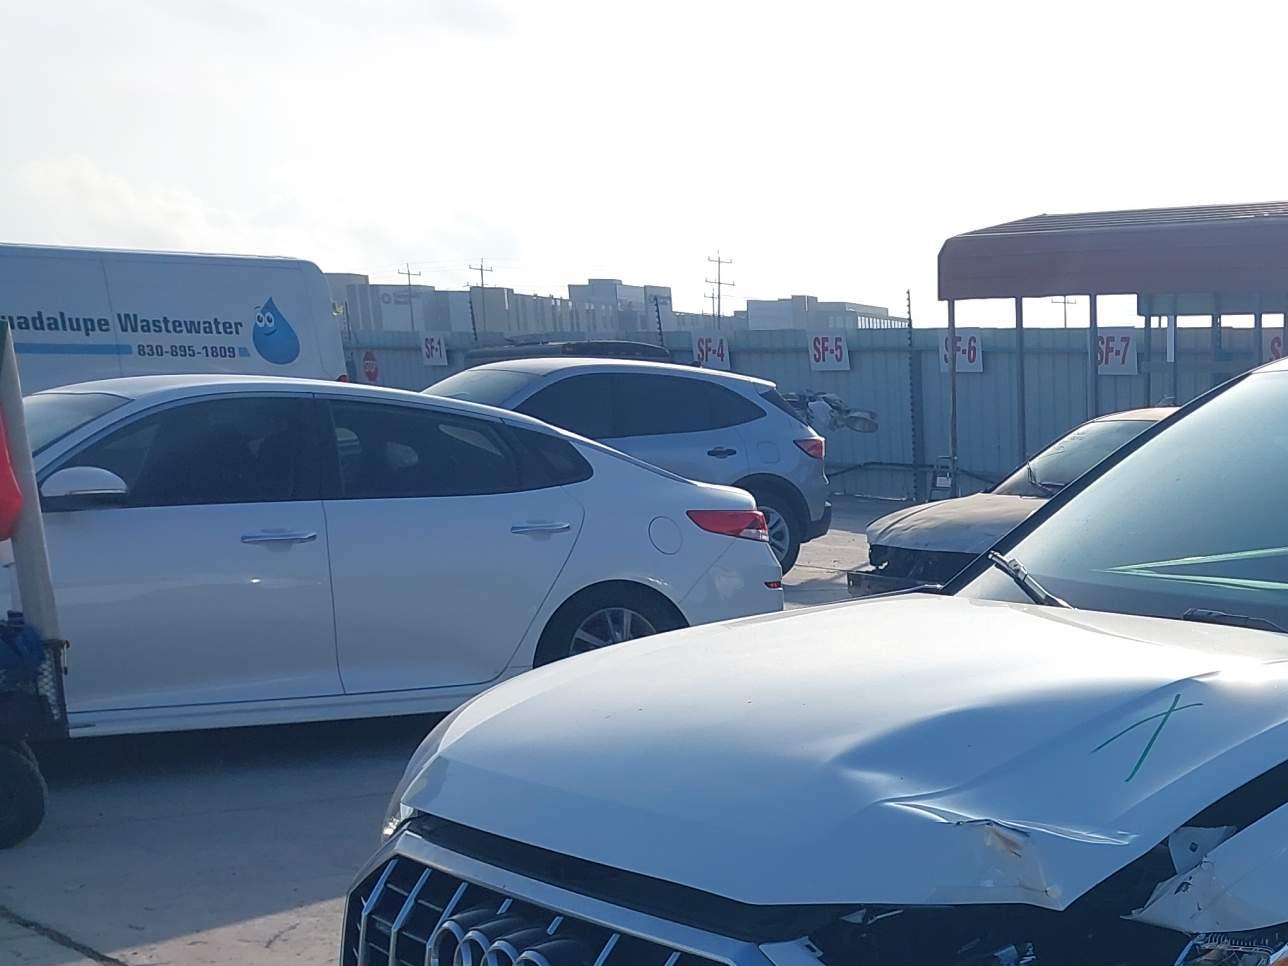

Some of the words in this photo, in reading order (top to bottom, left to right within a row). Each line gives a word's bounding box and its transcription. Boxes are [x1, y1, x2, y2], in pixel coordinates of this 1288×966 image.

[117, 313, 243, 335] Wastewater
[137, 344, 236, 358] 830-895-1809
[425, 337, 442, 359] SF-1
[697, 338, 725, 362] SF-4
[813, 336, 843, 363] SF-5
